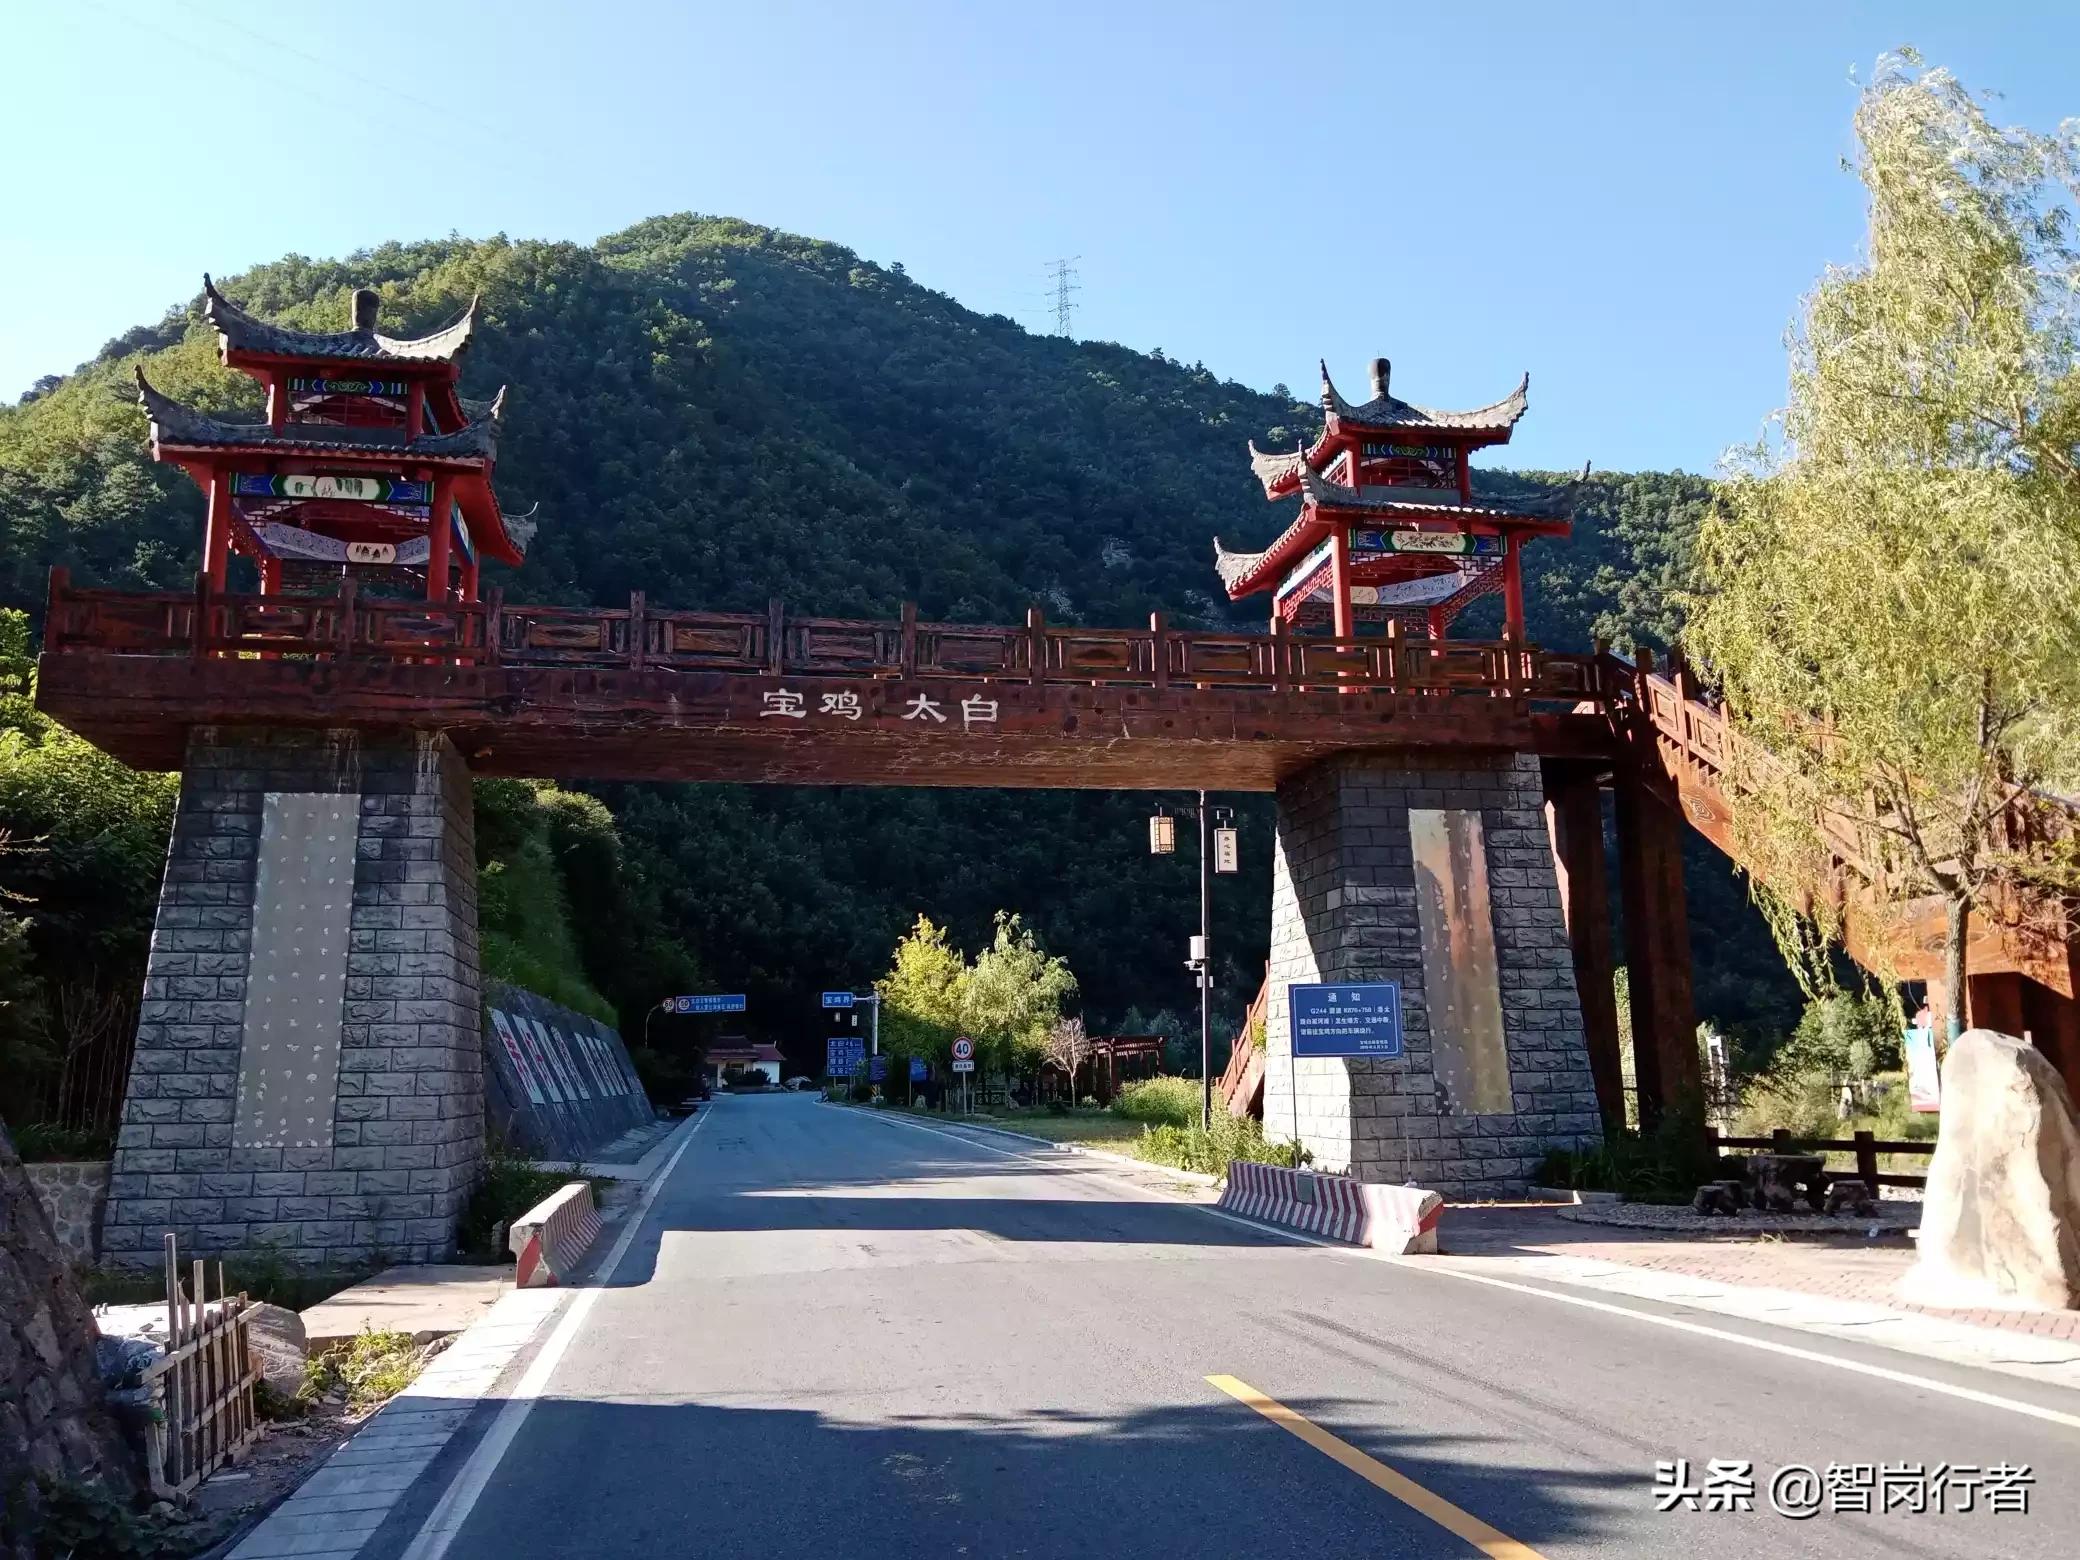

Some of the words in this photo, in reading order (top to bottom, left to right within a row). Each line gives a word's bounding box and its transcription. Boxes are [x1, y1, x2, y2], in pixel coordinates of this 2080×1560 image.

[759, 687, 863, 721] 宝鸡
[901, 692, 999, 724] 太白
[1328, 992, 1361, 1002] 通知
[956, 1043, 969, 1055] 40
